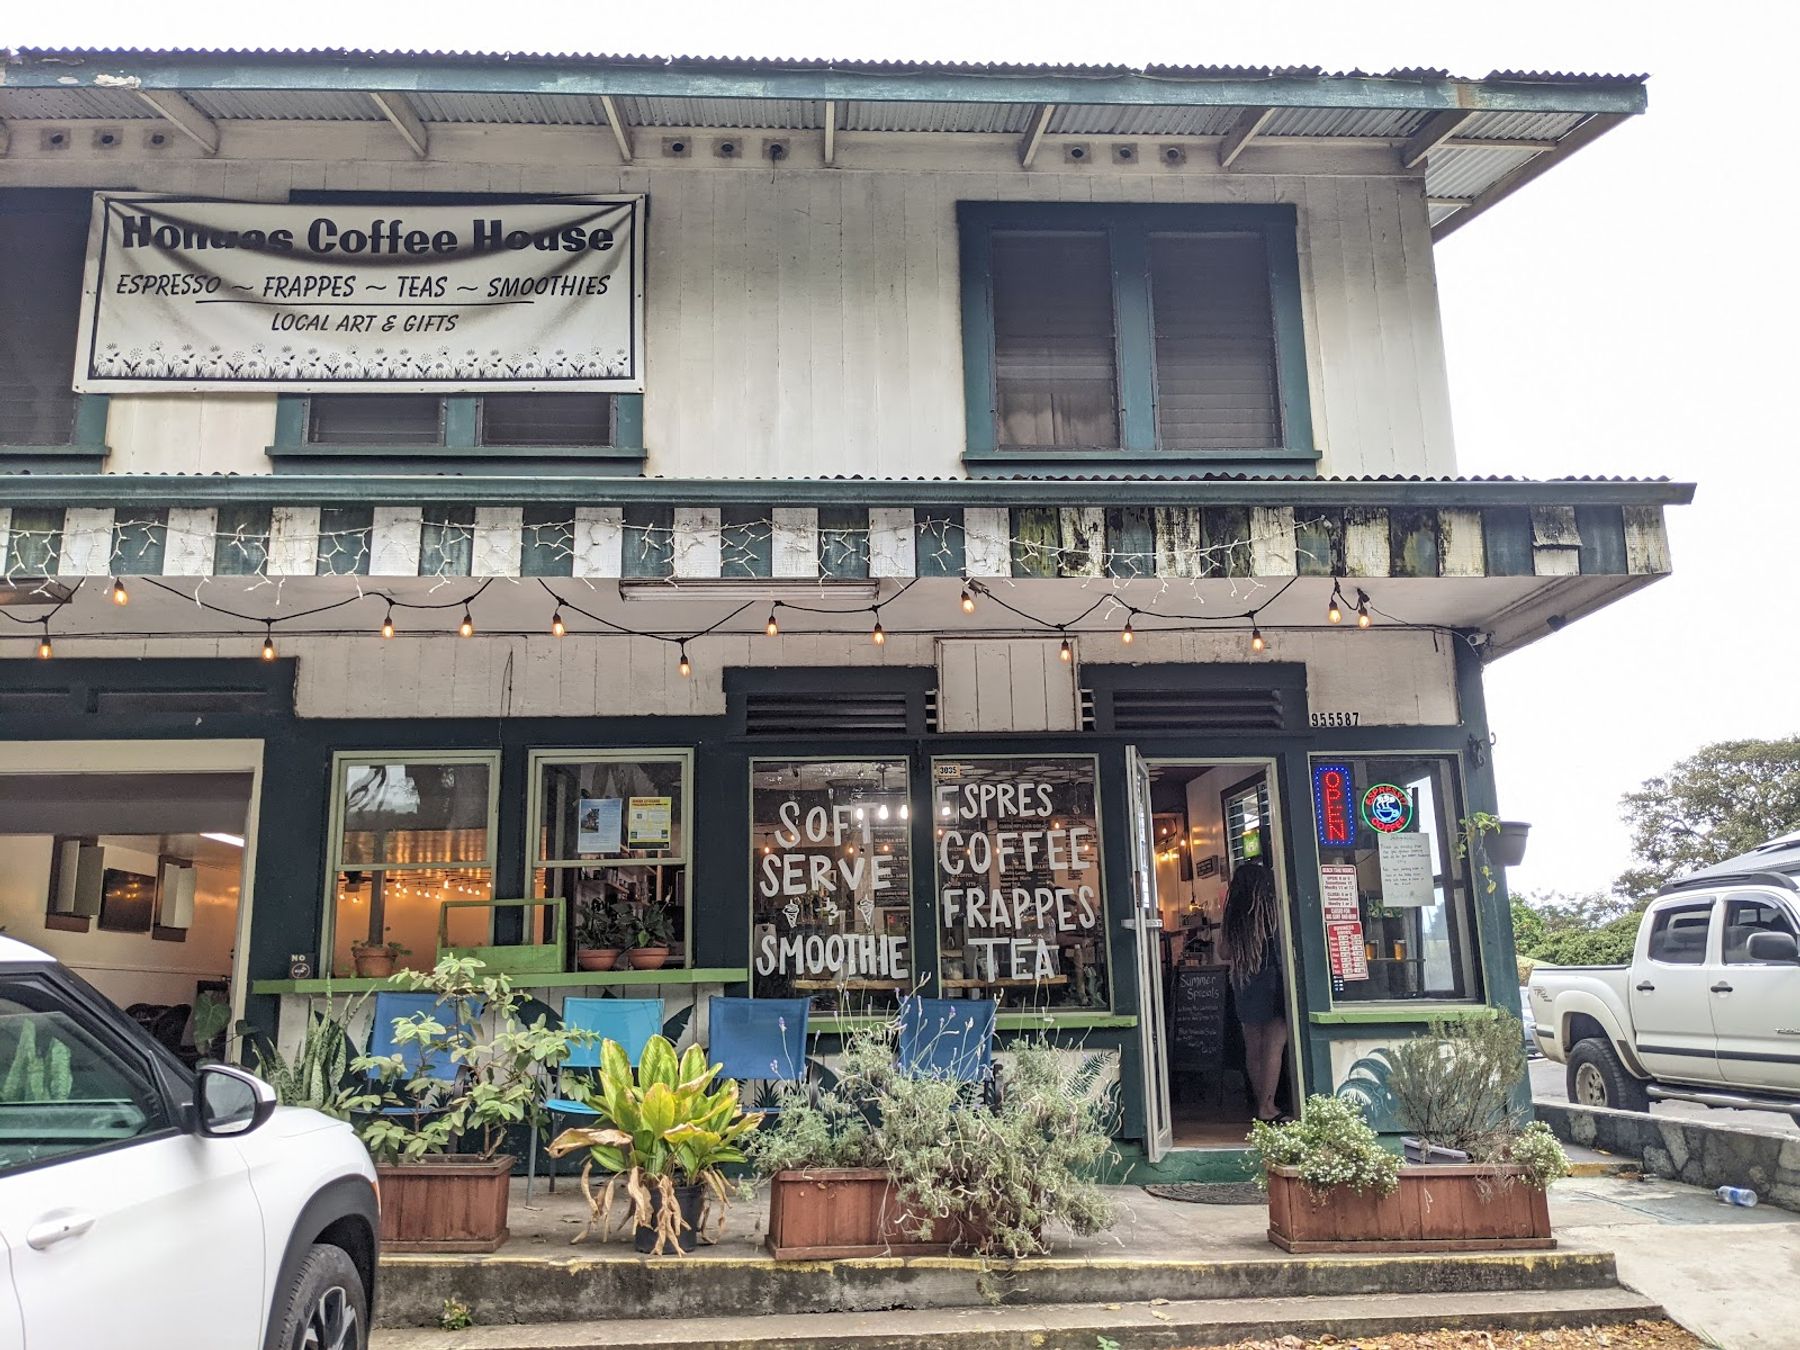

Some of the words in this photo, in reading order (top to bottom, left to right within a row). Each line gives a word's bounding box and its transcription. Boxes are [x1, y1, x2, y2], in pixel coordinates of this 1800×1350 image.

[307, 218, 458, 254] Coffee
[473, 219, 614, 252] House
[116, 274, 222, 296] ESPRESSO
[262, 275, 356, 298] FRAPPES
[397, 276, 448, 298] TEAS
[487, 275, 610, 297] SMOOTHIES
[271, 312, 329, 332] LOCAL
[335, 314, 377, 332] ART
[381, 315, 397, 332] &
[403, 314, 460, 332] GIFTS
[1311, 712, 1359, 727] 955587
[774, 801, 878, 848] SOFT
[1325, 771, 1345, 841] OPEN
[1371, 816, 1406, 832] COFFEE
[940, 828, 1092, 875] COFFEE
[759, 854, 895, 898] SERVE
[943, 885, 1096, 931] FRAPPES
[291, 954, 306, 962] NO
[755, 933, 909, 980] SMOOTHIE
[967, 937, 1056, 983] TEA
